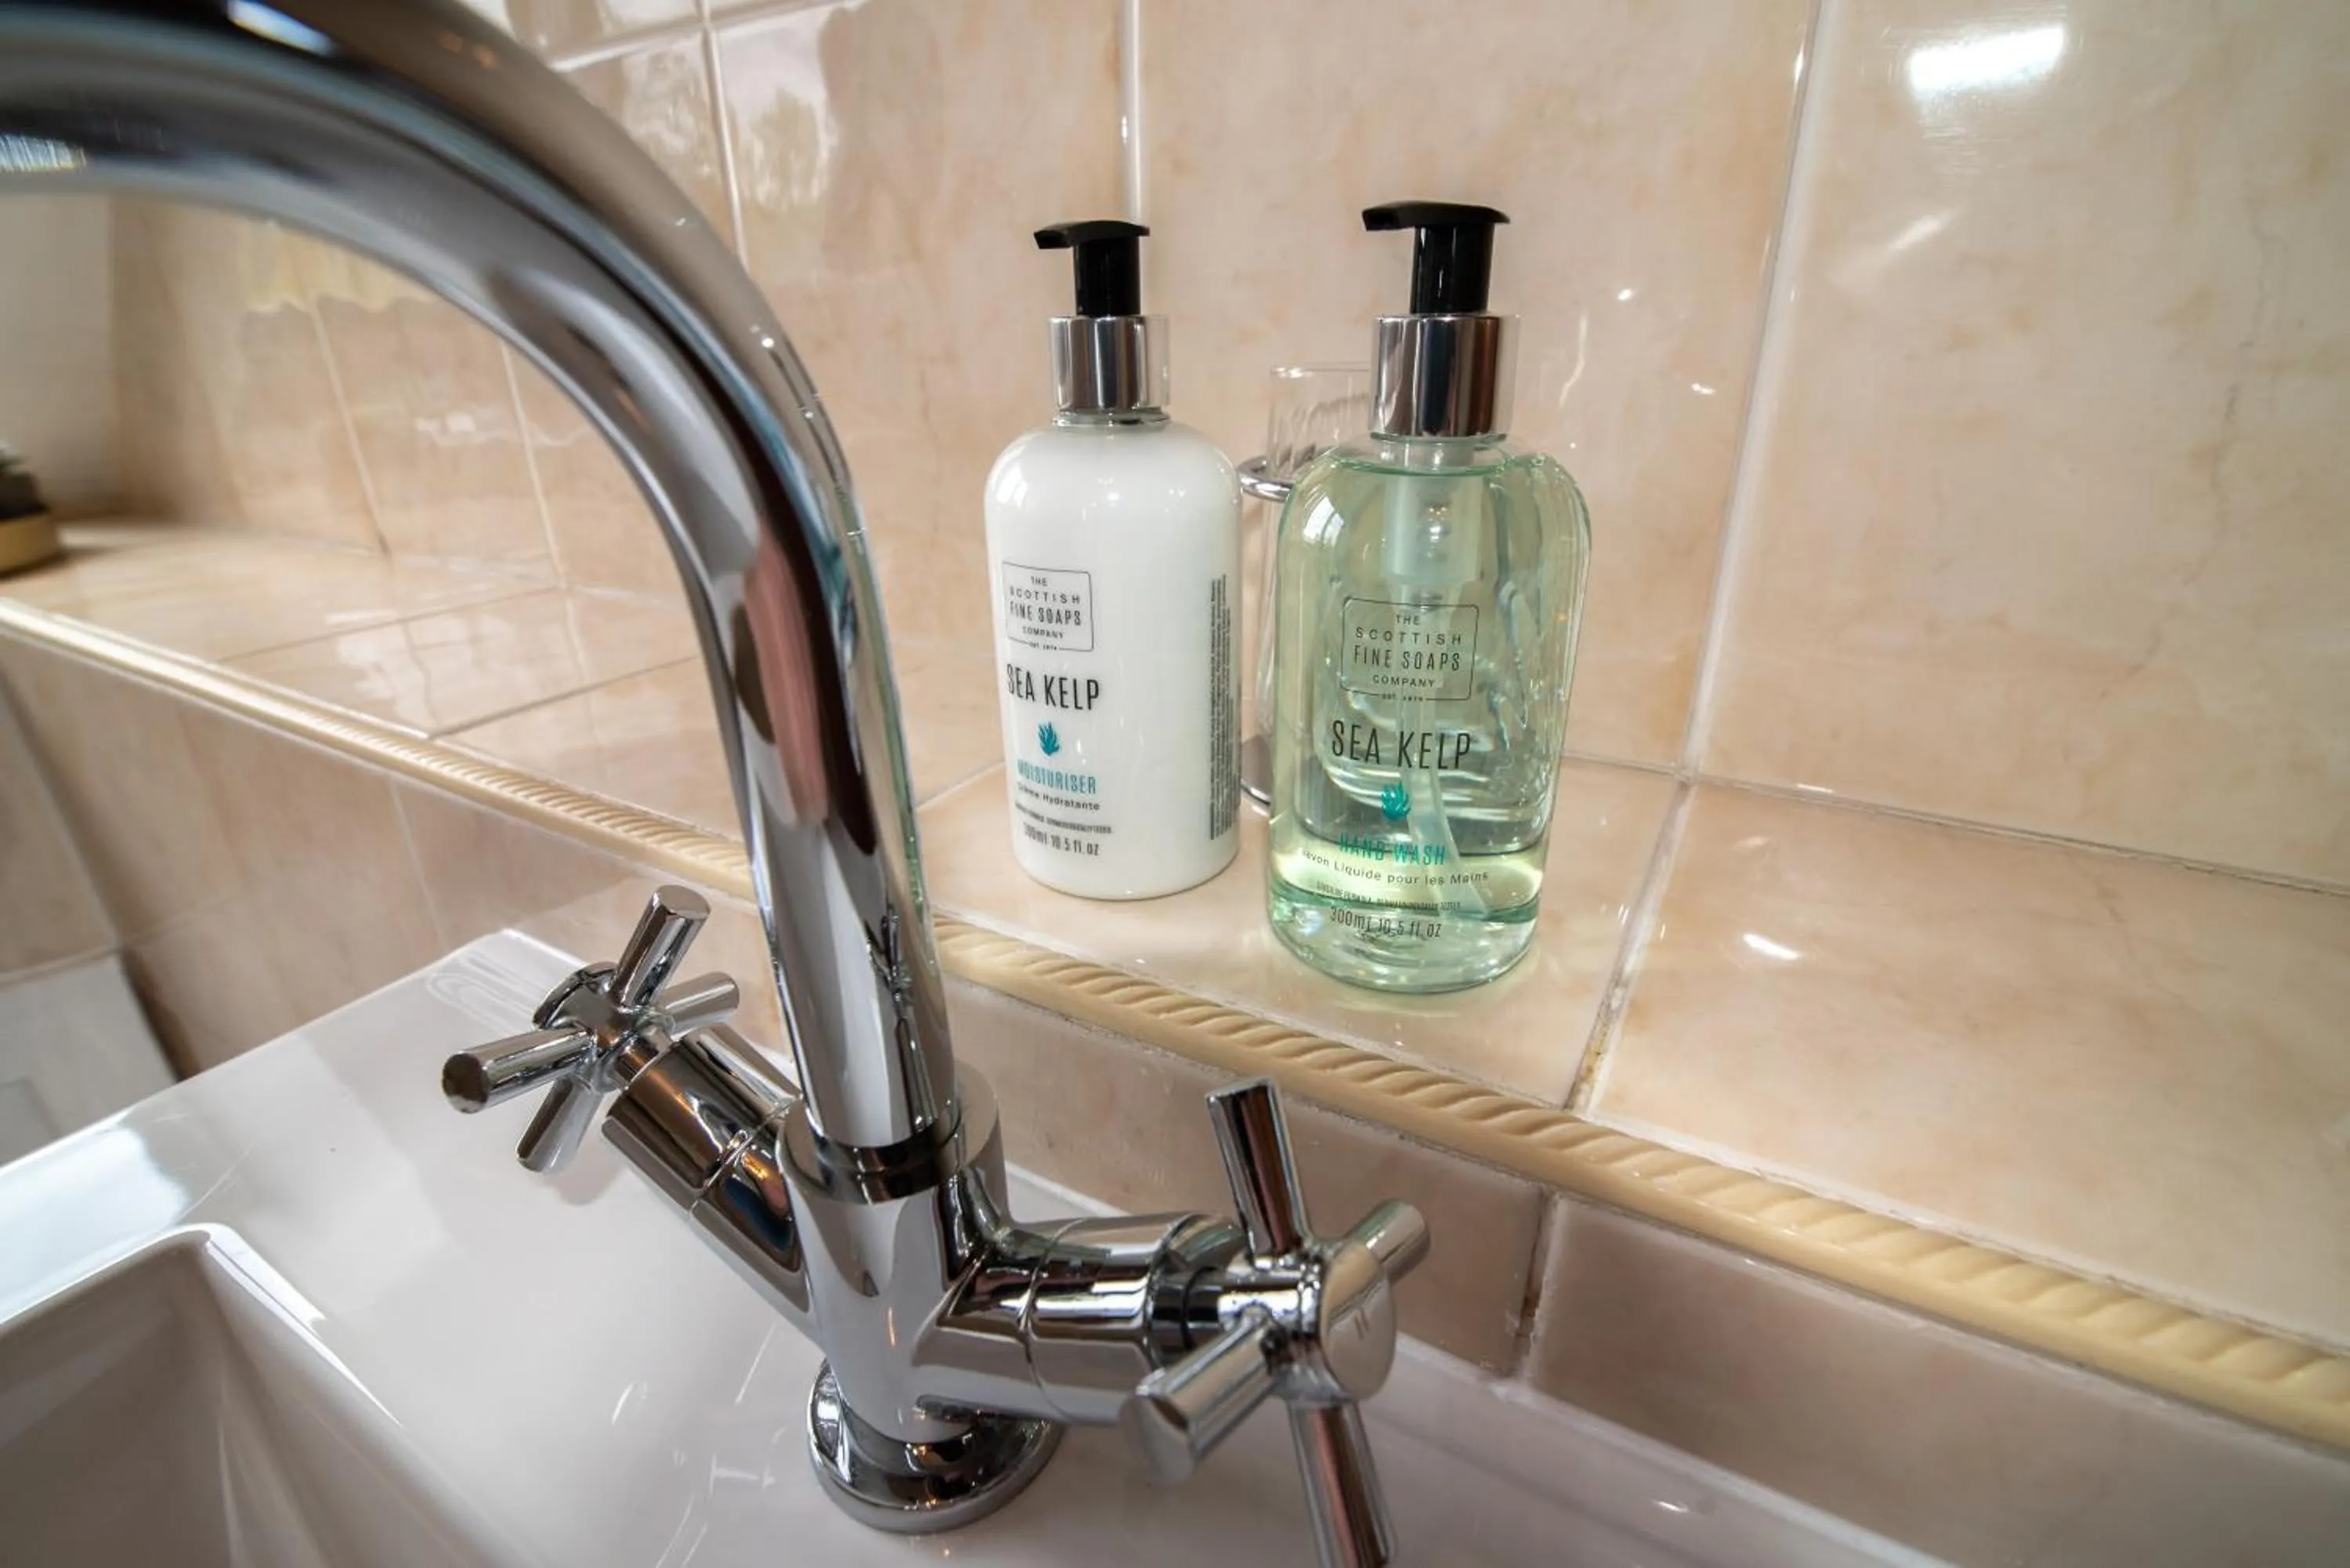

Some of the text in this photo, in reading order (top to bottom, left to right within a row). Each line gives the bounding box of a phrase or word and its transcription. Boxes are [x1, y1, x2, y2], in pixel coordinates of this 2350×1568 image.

[1031, 576, 1047, 587] THE
[1009, 586, 1080, 604] SCOTTISH
[1010, 600, 1082, 626] FINE SOAPS
[1397, 614, 1420, 626] THE
[1022, 626, 1063, 639] COMPANY
[1356, 627, 1462, 645] SCOTTISH
[1354, 645, 1460, 671] FINE SOAPS
[1007, 663, 1099, 711] SEA KELP
[1373, 674, 1435, 688] COMPANY
[1332, 720, 1470, 770] SEA KELP
[1017, 759, 1097, 794] MOISTURISER
[1339, 833, 1446, 865] HAND WASH
[1334, 861, 1382, 881] Liquide
[1387, 873, 1420, 885] pour
[1425, 875, 1445, 886] les
[1450, 871, 1488, 885] Mains
